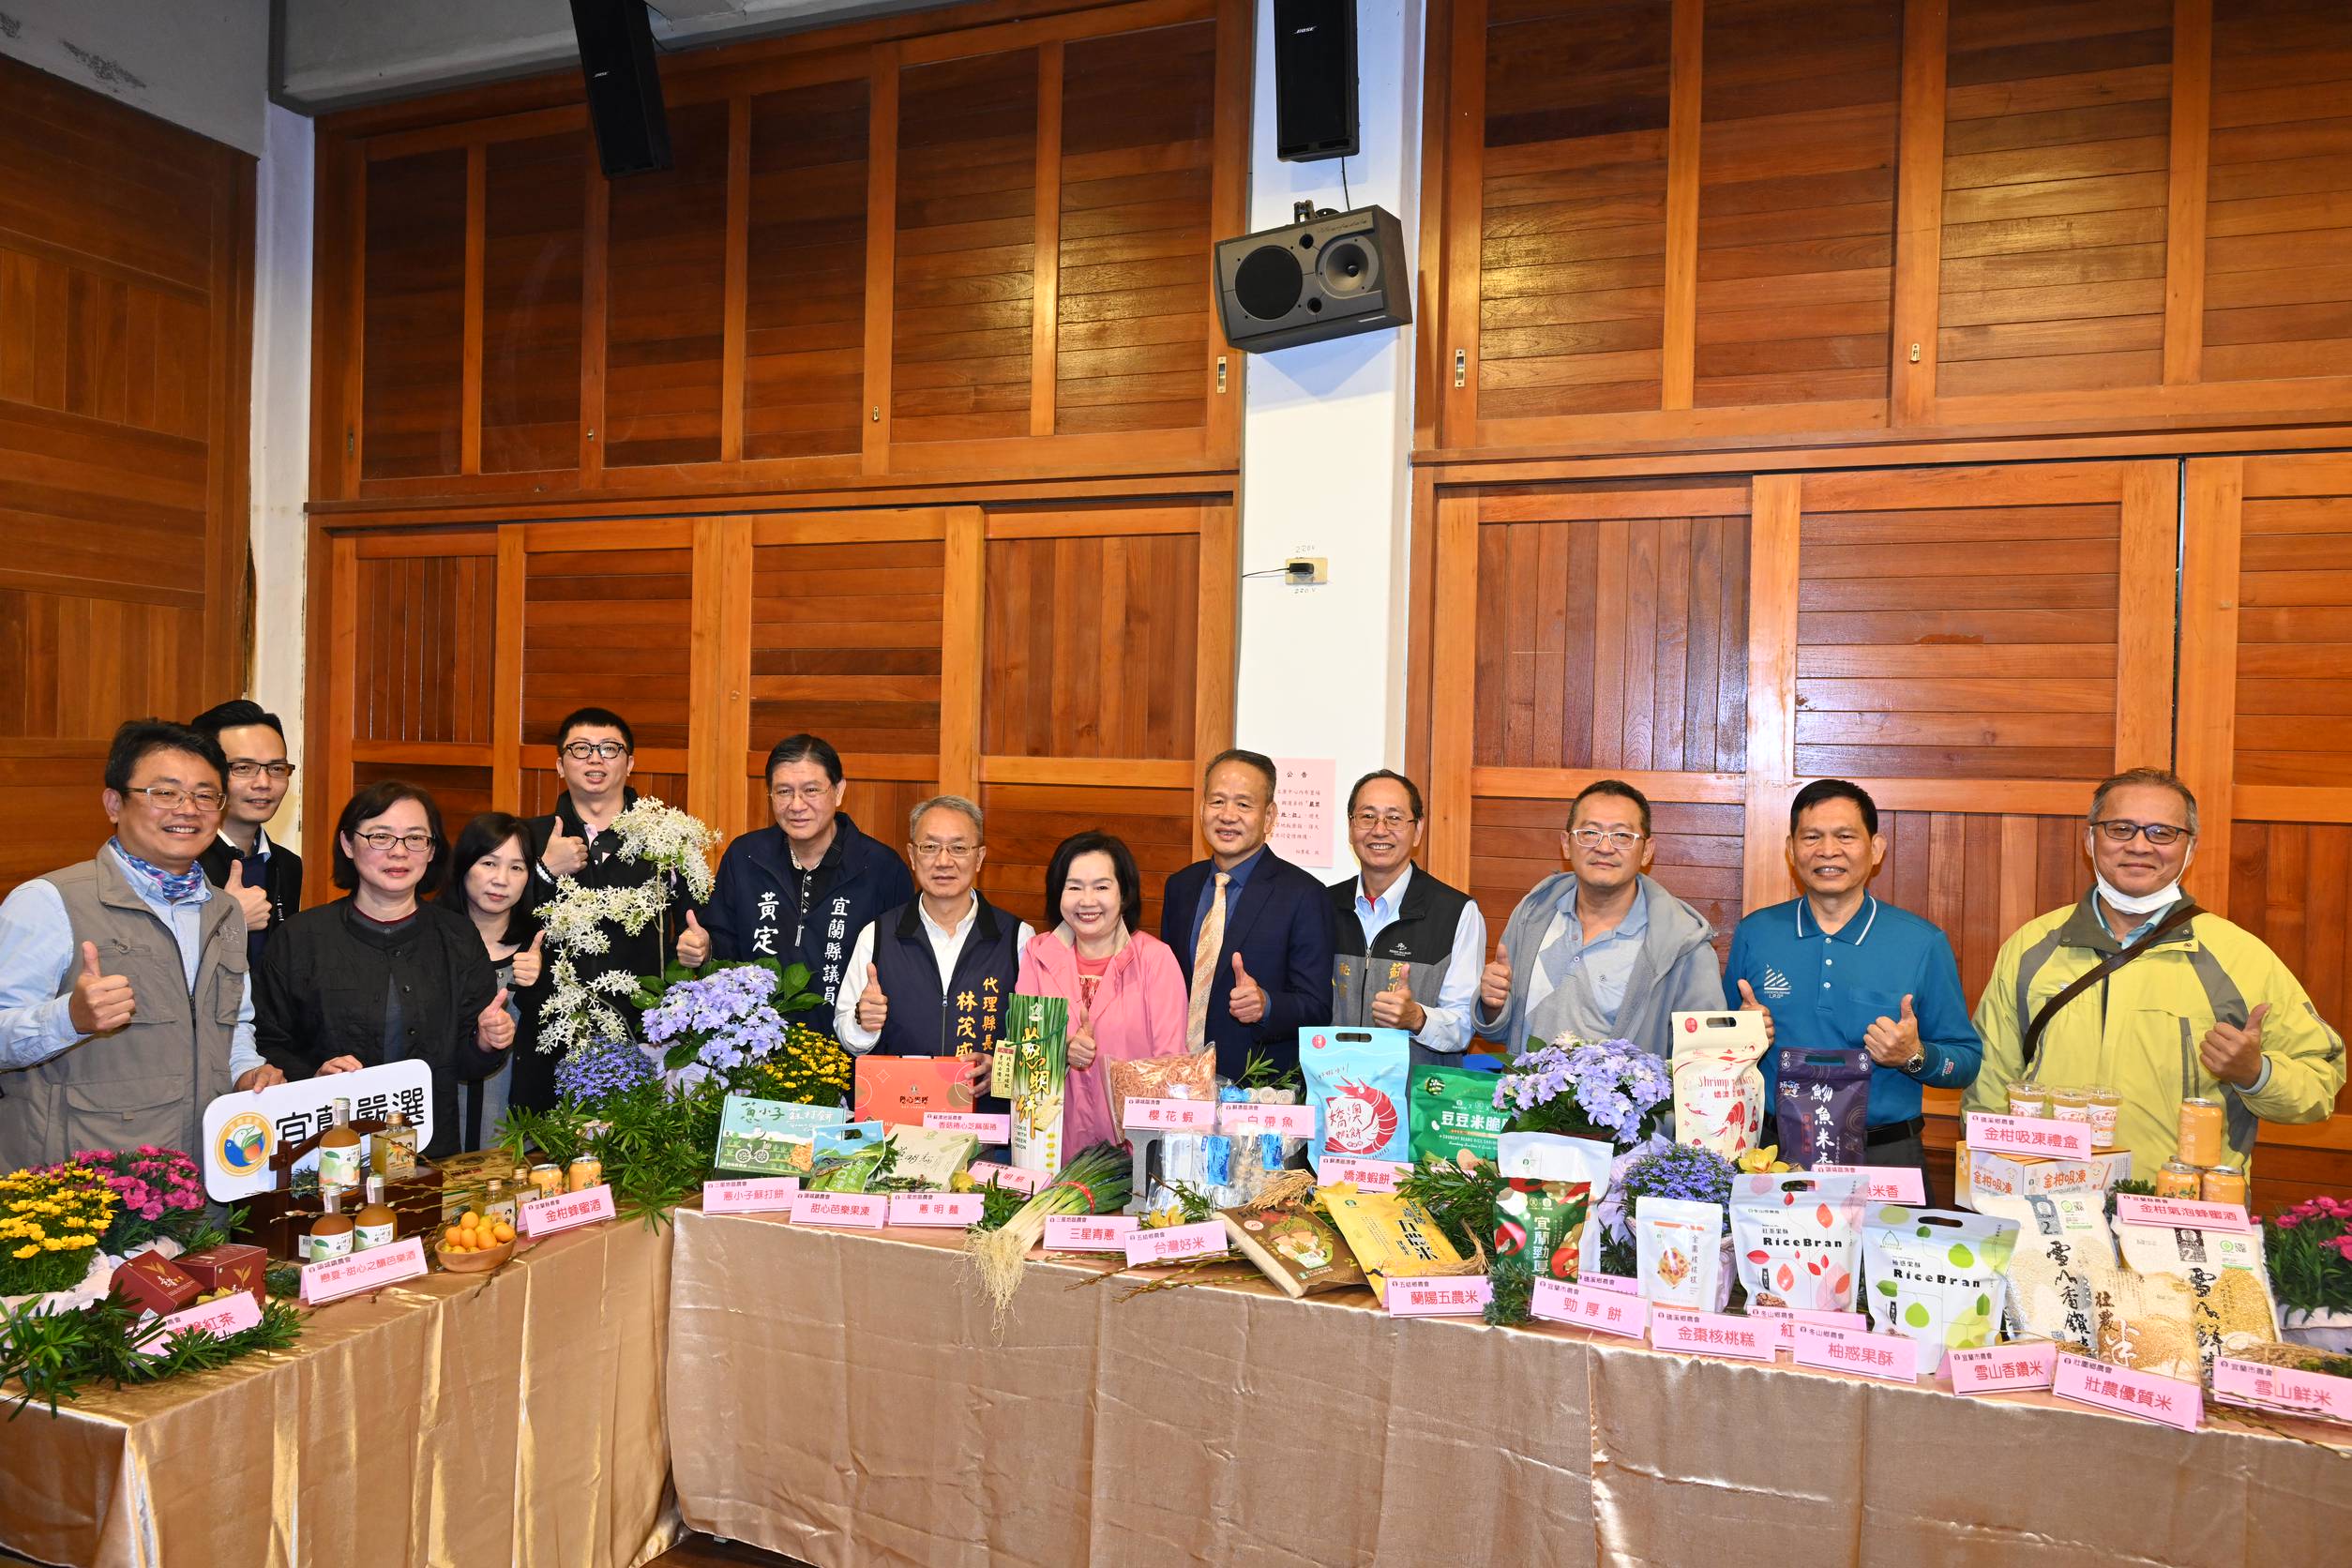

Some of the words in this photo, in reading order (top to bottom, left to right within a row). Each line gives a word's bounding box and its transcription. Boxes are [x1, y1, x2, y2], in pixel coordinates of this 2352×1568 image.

[753, 891, 780, 955] 黃定
[822, 897, 851, 1006] 宜蘭縣議員
[982, 977, 999, 1051] 代理縣長
[1148, 1109, 1194, 1123] 櫻花蝦
[1247, 1114, 1293, 1128] 白帶魚
[1984, 1126, 2079, 1151] 金柑吸凍禮盒
[1343, 1169, 1390, 1185] 嬌澳蝦餅
[1973, 1171, 2013, 1195] 金柑吸凍
[2043, 1169, 2087, 1189] 金柑吸凍
[723, 1189, 784, 1201] 蔥小子蘇打餅
[545, 1199, 602, 1223] 金柑蜂蜜酒
[809, 1202, 871, 1217] 甜心芭樂果凍
[2140, 1203, 2238, 1222] 金柑氣泡蜂蜜酒
[1069, 1228, 1115, 1242] 三星青蔥
[1763, 1237, 1843, 1248] RiceBran
[1153, 1236, 1206, 1255] 台灣好米
[1893, 1268, 1981, 1288] RiceBran
[1410, 1289, 1479, 1306] 蘭陽五農米
[1562, 1296, 1622, 1322] 勁厚餅
[1678, 1326, 1756, 1347] 金棗核桃糕
[1828, 1342, 1894, 1366] 柚惑果酥
[1974, 1360, 2044, 1380] 雪山香鑽米
[2084, 1375, 2174, 1412] 壯農優質米
[2254, 1379, 2333, 1407] 雪山鮮米
